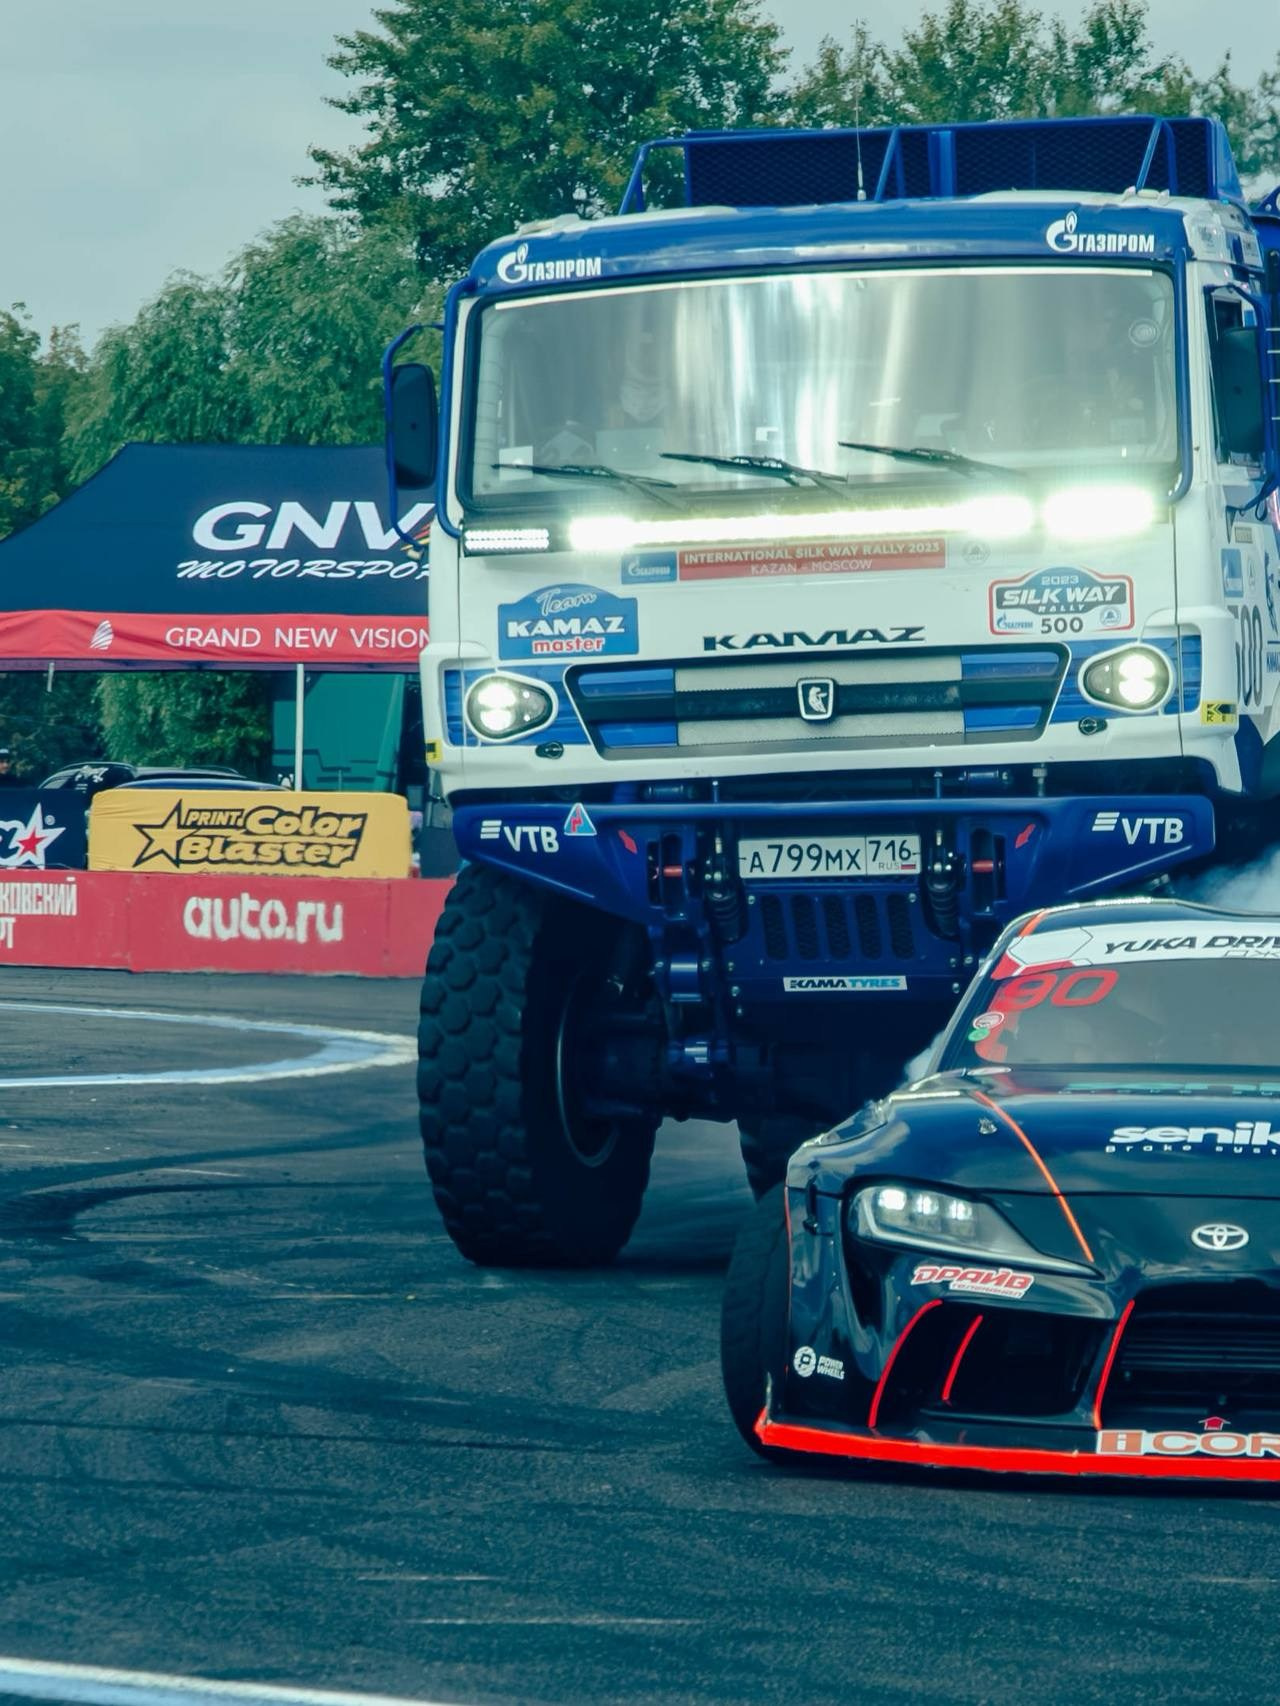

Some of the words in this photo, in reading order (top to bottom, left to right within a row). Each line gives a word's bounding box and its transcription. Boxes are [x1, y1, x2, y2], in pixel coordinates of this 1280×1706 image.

[192, 501, 436, 551] GNV
[684, 548, 793, 565] INTERNATIONAL
[795, 547, 824, 559] SILK
[828, 545, 859, 557] WAY
[863, 543, 905, 555] RALLY
[908, 541, 940, 553] 2023
[751, 563, 797, 576] KAZAN
[812, 559, 873, 572] MOSCOW
[1041, 575, 1079, 586] 2023
[536, 588, 597, 616] Team
[1002, 588, 1063, 606] SILK
[1066, 585, 1120, 603] WAY
[1038, 604, 1085, 613] RALLY
[507, 617, 625, 638] KAMAZ
[1041, 617, 1084, 634] 500
[165, 627, 261, 648] GRAND
[275, 628, 337, 648] NEW
[533, 637, 605, 654] master
[703, 626, 926, 651] KAMAZ
[245, 806, 366, 838] Color
[1122, 818, 1184, 844] VTB
[504, 826, 560, 853] VTB
[180, 835, 356, 867] Blaster
[869, 840, 911, 862] 716
[878, 862, 900, 870] RUS
[183, 892, 343, 943] auto.ru
[1105, 936, 1198, 954] YUKA
[790, 979, 847, 989] KAMA
[848, 978, 900, 988] TYRES
[1000, 969, 1119, 1012] 90
[1105, 1144, 1193, 1153] Brake
